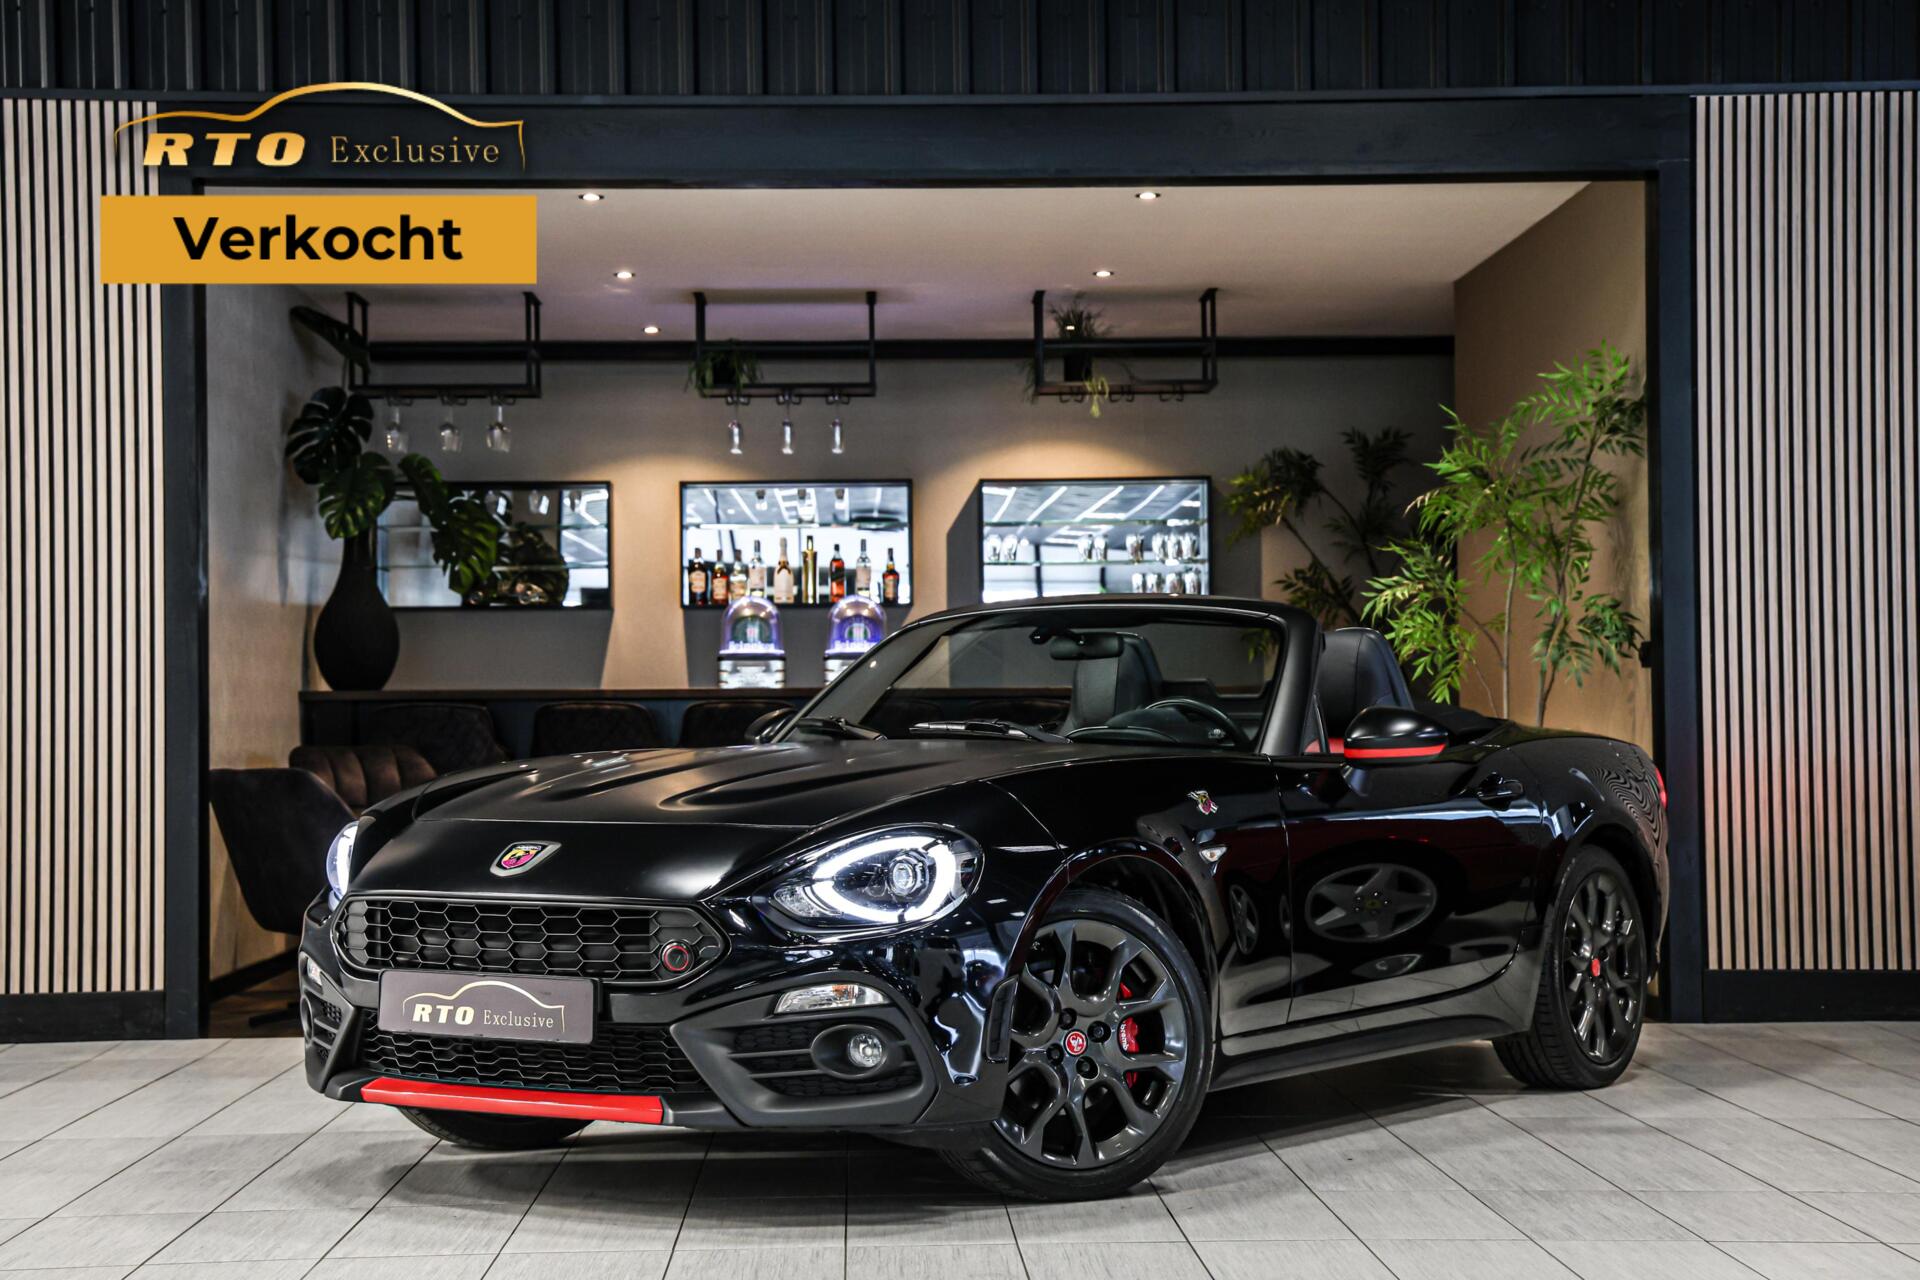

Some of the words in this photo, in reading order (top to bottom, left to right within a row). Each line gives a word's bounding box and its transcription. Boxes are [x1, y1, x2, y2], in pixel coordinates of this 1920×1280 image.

[412, 1003, 475, 1025] RTO
[483, 1009, 554, 1029] Exclusive
[1120, 1024, 1129, 1051] bremb
